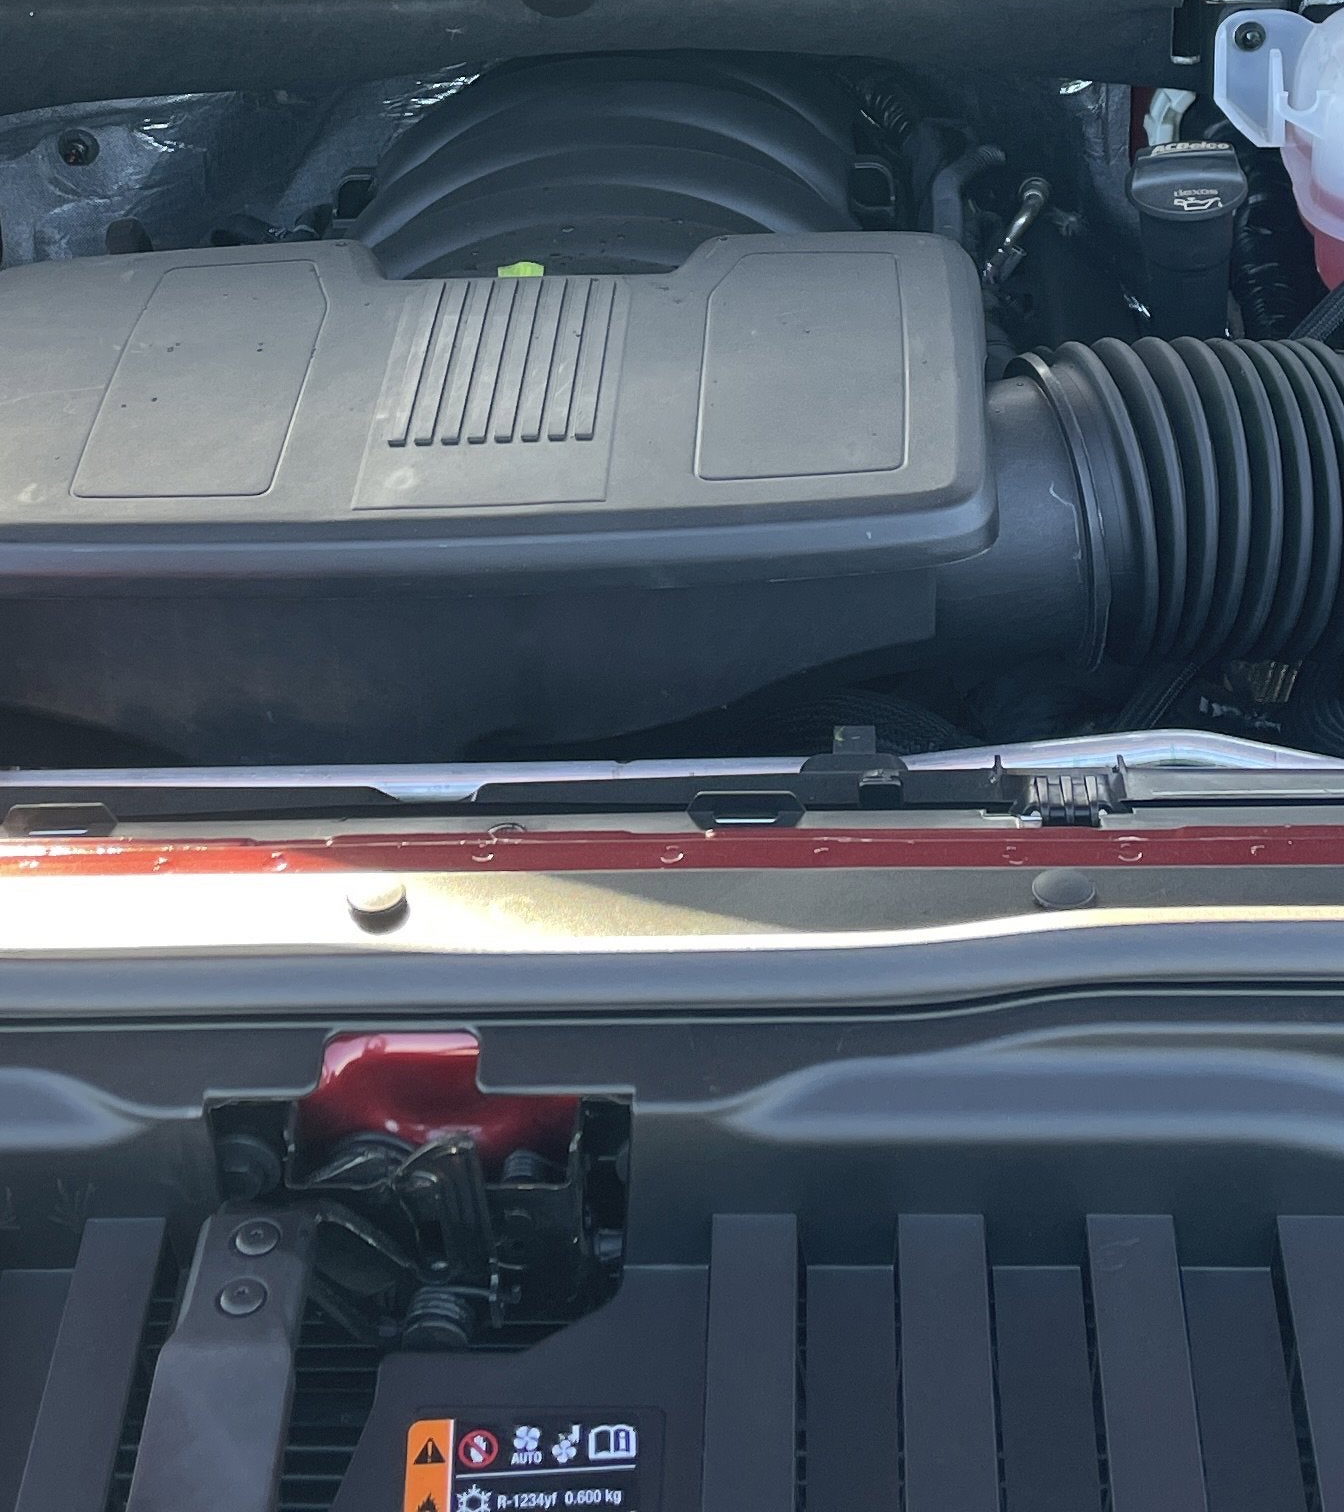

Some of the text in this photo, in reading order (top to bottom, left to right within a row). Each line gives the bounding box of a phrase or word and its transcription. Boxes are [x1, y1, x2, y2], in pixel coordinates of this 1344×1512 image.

[1151, 141, 1230, 156] ACDelco
[511, 1451, 542, 1465] AUTO
[497, 1488, 622, 1509] R-1234yf 0.600 kg
